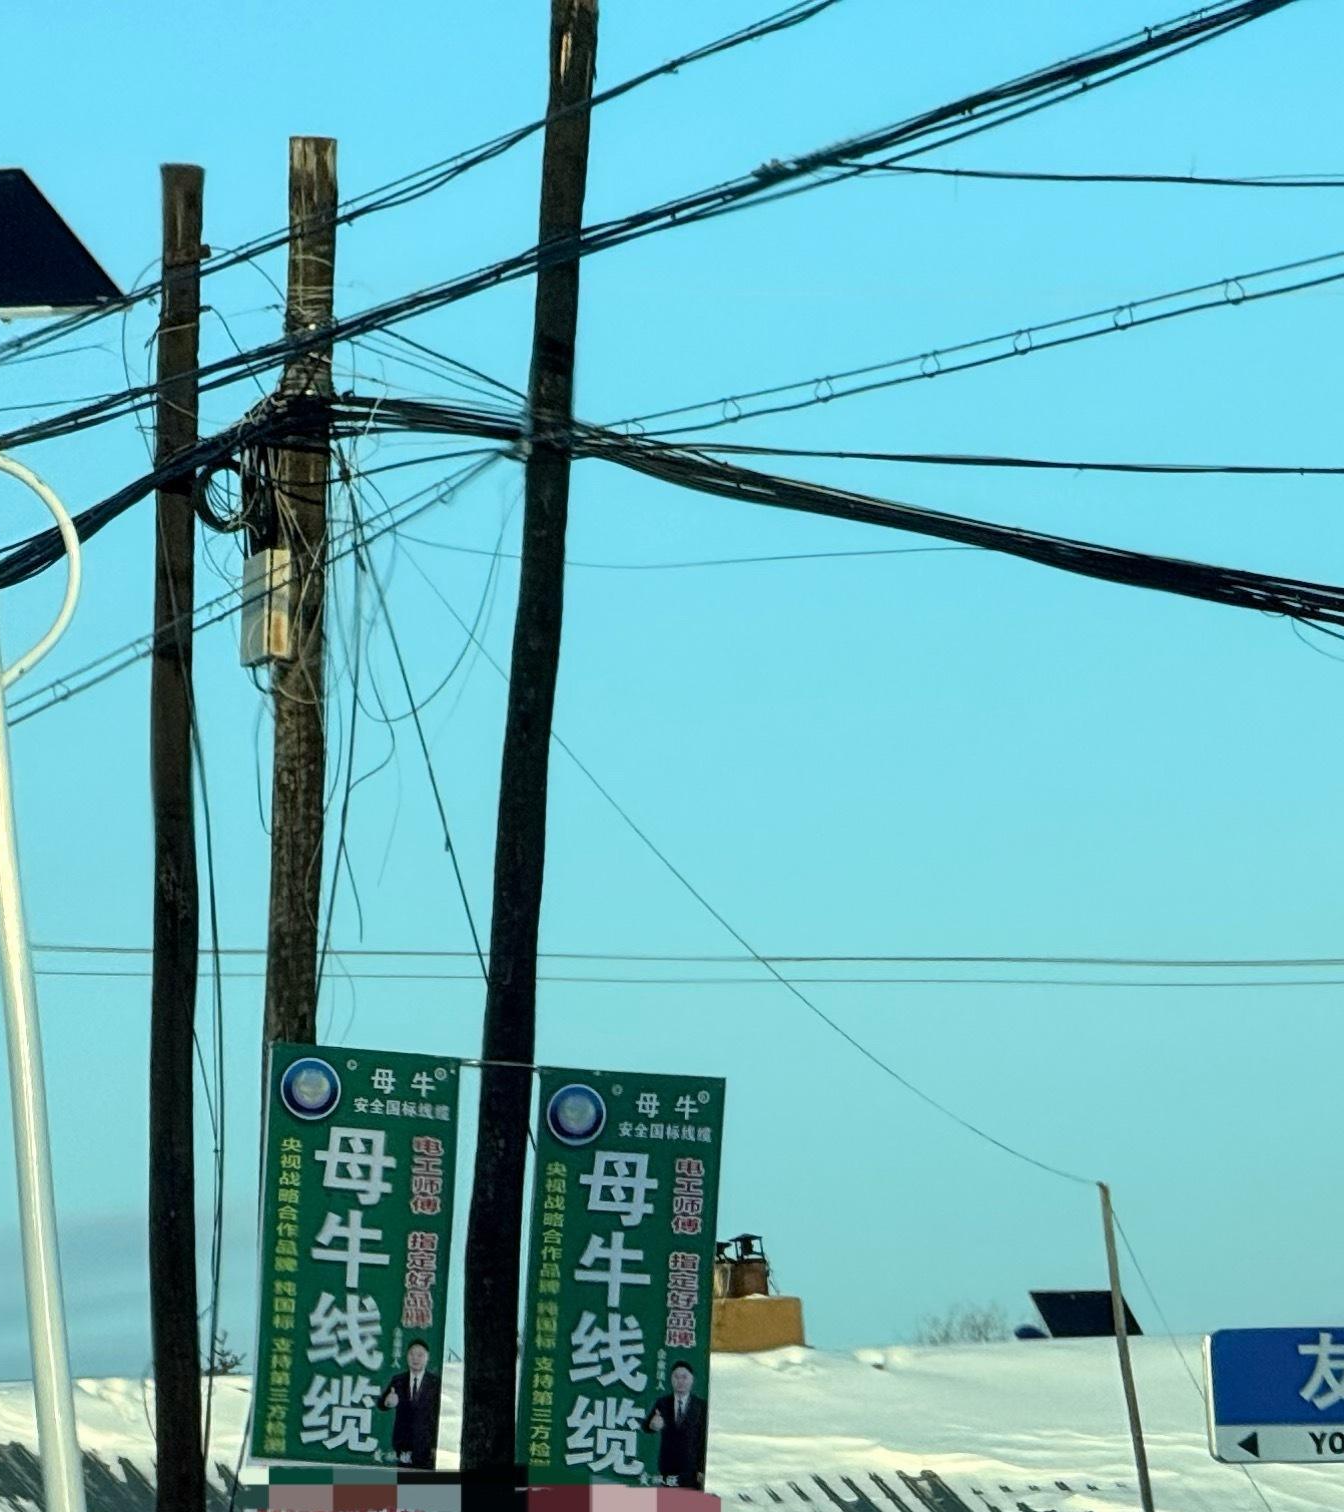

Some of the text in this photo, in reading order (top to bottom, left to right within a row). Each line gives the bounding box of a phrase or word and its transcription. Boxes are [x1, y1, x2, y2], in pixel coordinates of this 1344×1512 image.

[371, 1068, 436, 1097] 母牛
[635, 1092, 699, 1120] 母牛
[300, 1126, 397, 1452] 母牛线缆
[565, 1150, 658, 1475] 母牛线缆
